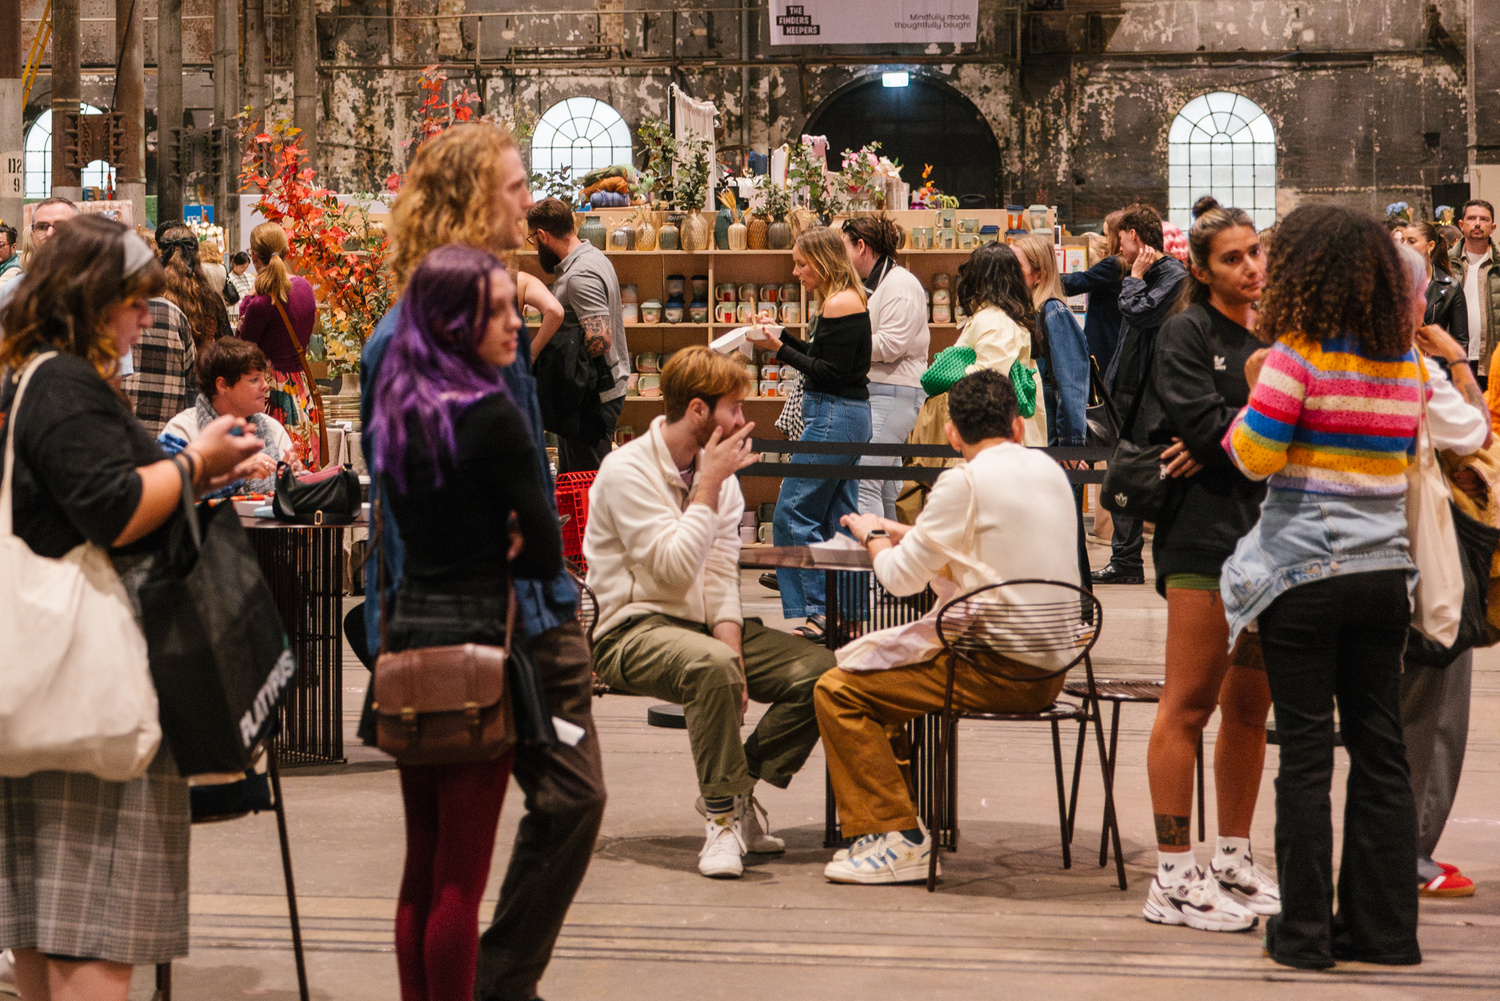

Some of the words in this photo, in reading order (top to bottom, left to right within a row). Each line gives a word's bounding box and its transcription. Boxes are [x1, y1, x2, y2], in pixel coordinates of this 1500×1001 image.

[789, 6, 803, 16] THE
[779, 16, 810, 25] FINDERS
[786, 26, 818, 35] KEEPERS
